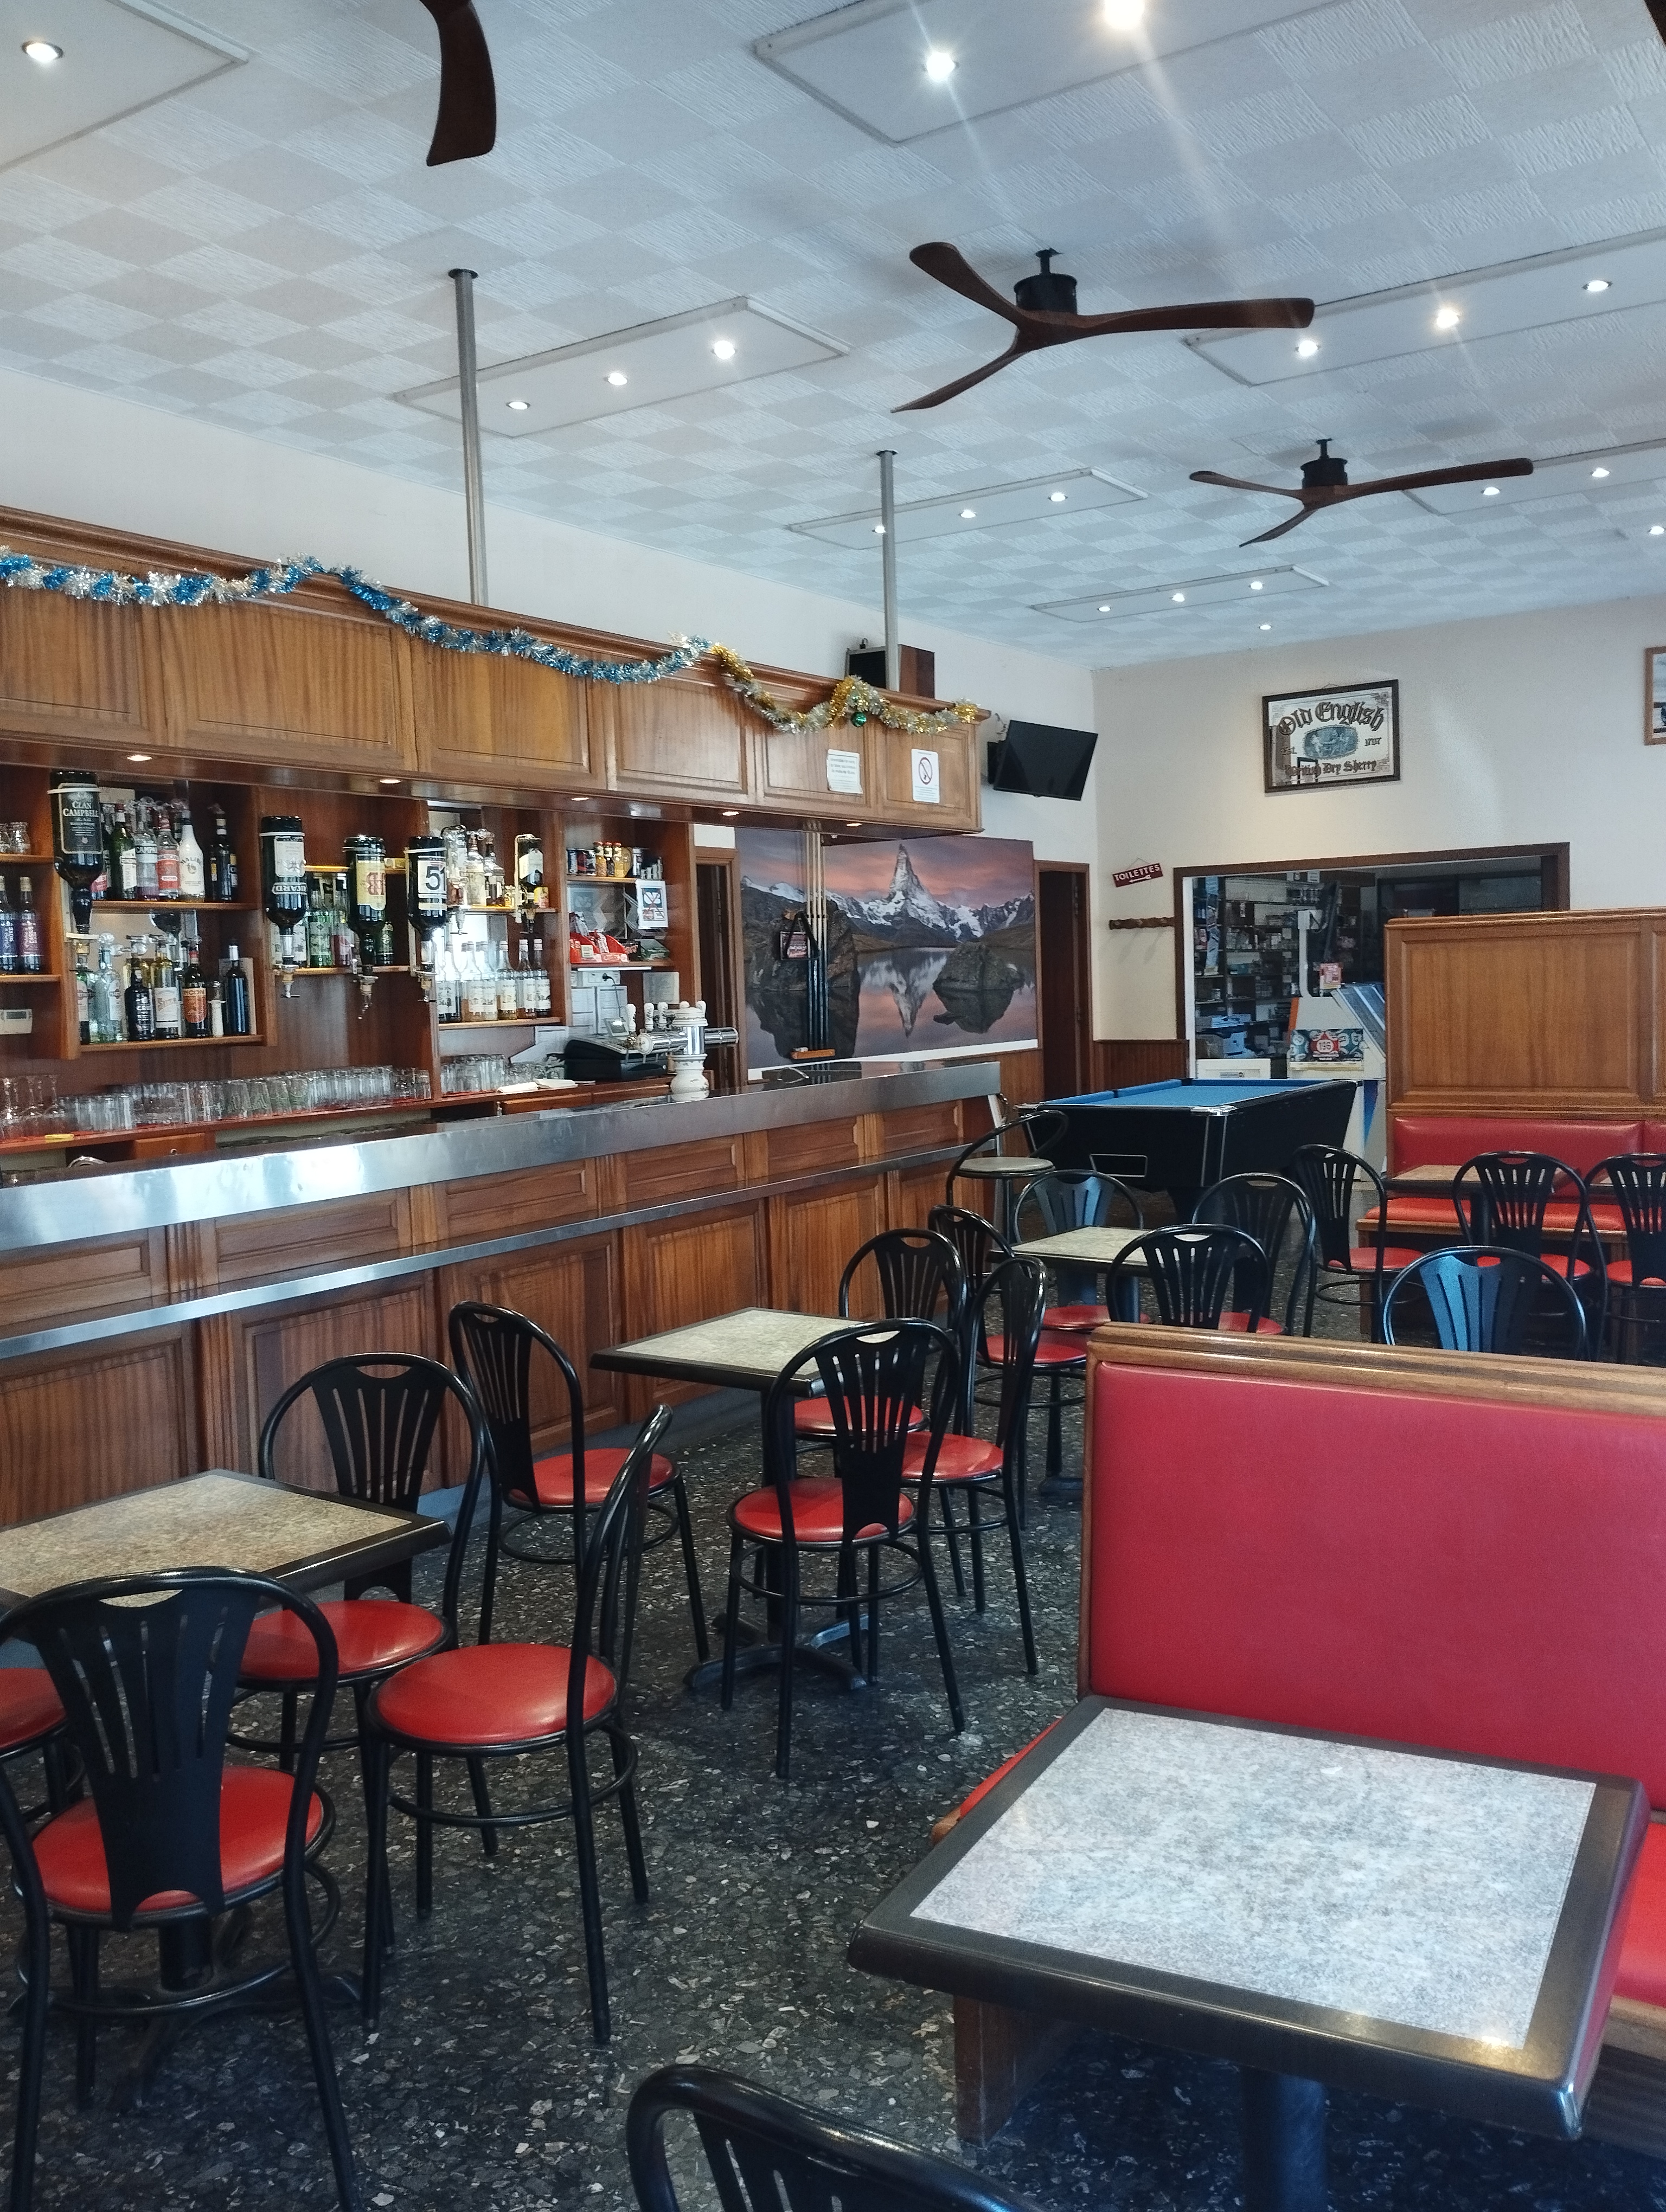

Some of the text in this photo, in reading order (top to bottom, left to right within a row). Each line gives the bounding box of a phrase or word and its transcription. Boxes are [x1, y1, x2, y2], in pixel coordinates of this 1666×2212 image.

[1277, 702, 1385, 735] Old English
[1322, 763, 1341, 775] Dry
[1343, 760, 1376, 773] Sherry
[425, 865, 445, 891] 51
[1114, 864, 1160, 881] TOILETTES
